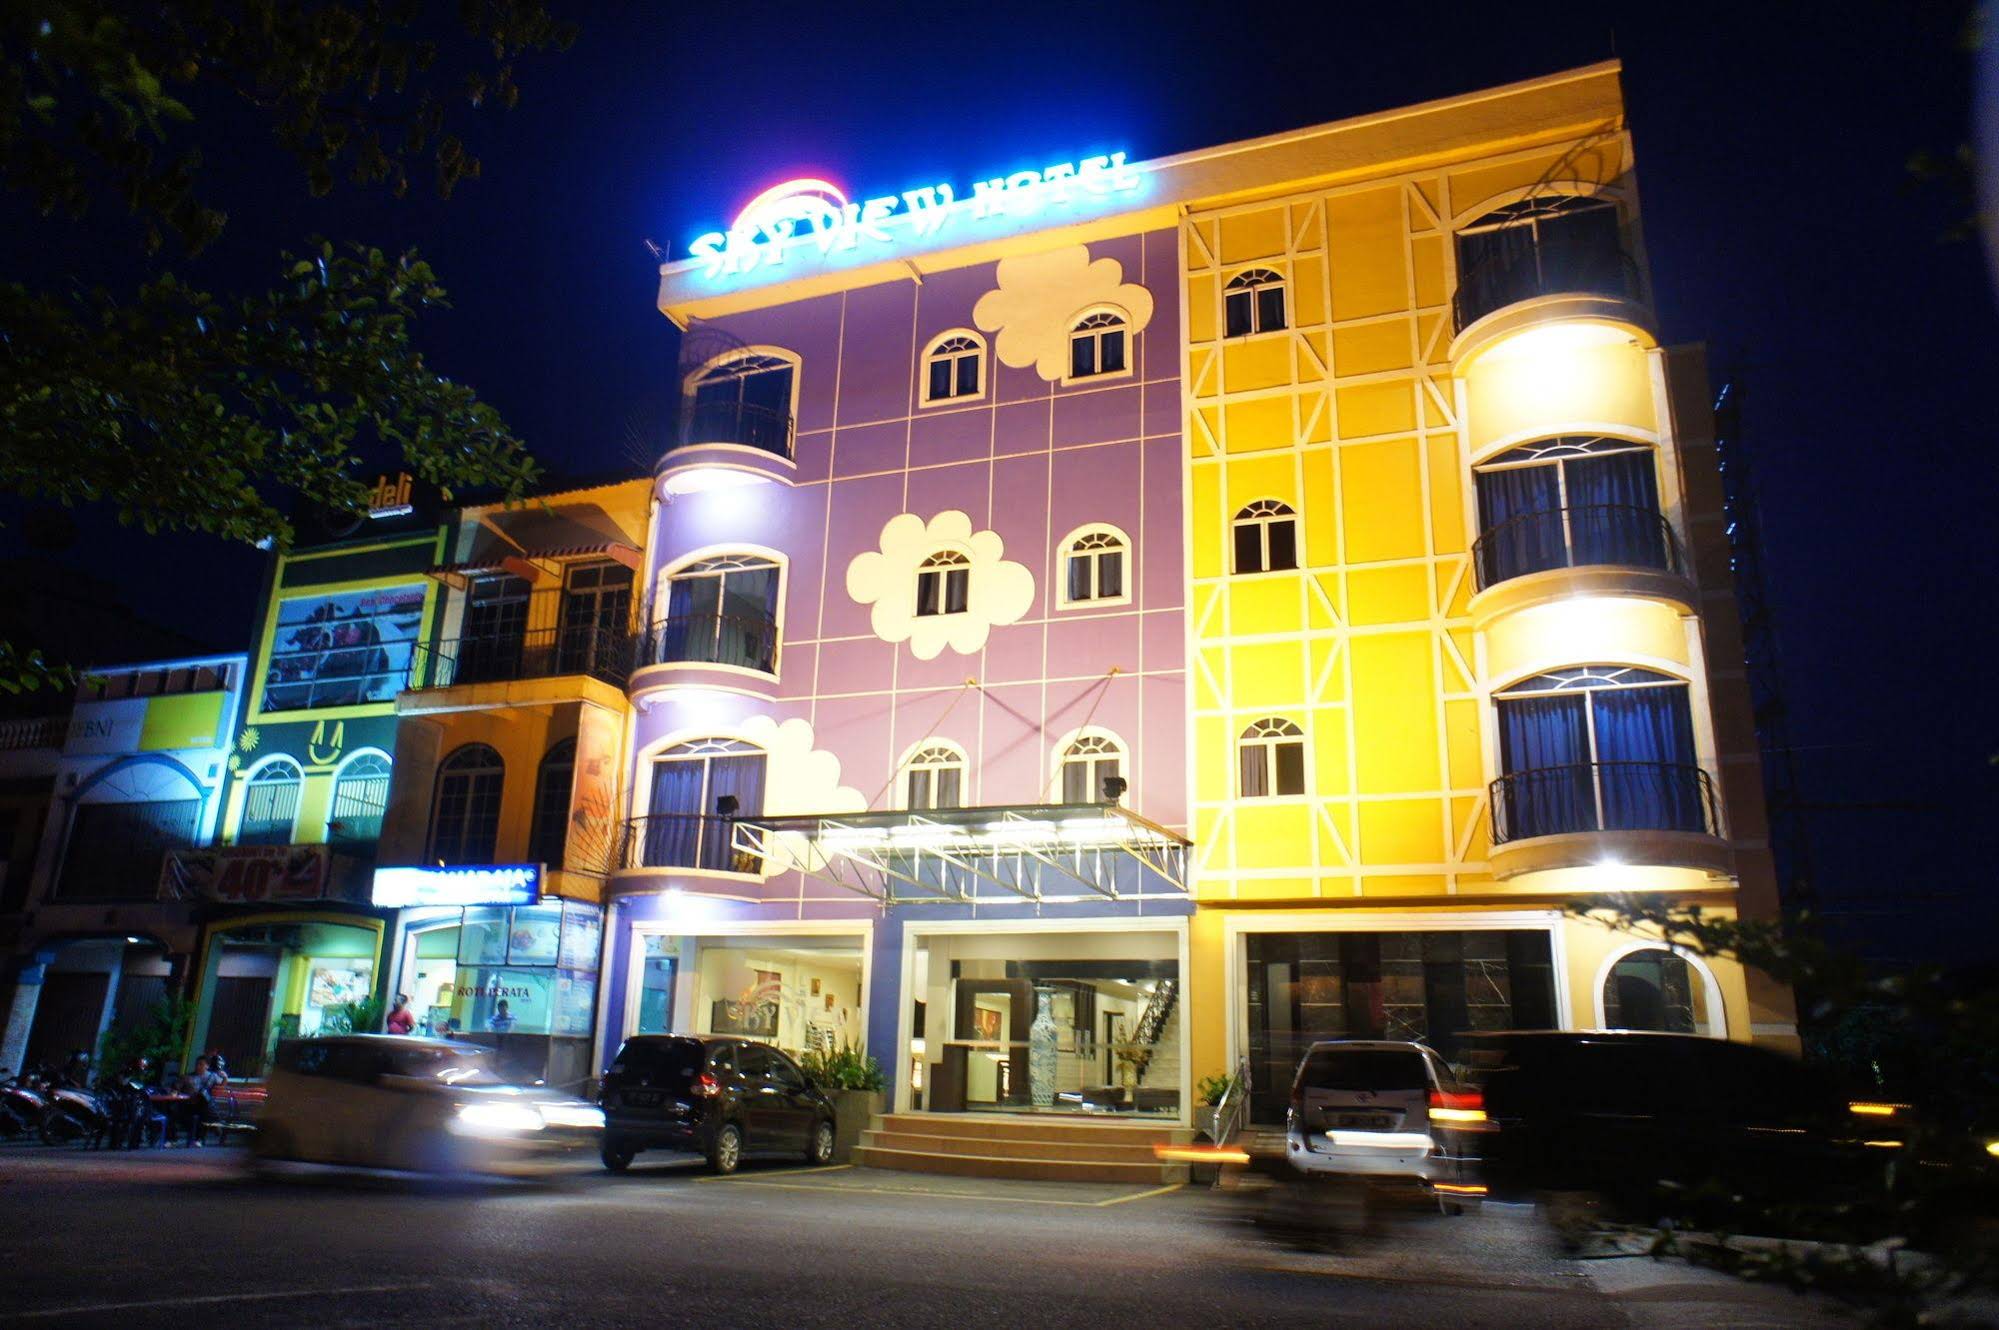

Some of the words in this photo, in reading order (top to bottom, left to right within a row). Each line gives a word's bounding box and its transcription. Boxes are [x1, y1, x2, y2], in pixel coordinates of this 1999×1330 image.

[689, 217, 796, 280] SKY
[804, 183, 955, 258] VIEW
[973, 152, 1142, 221] HOTEL
